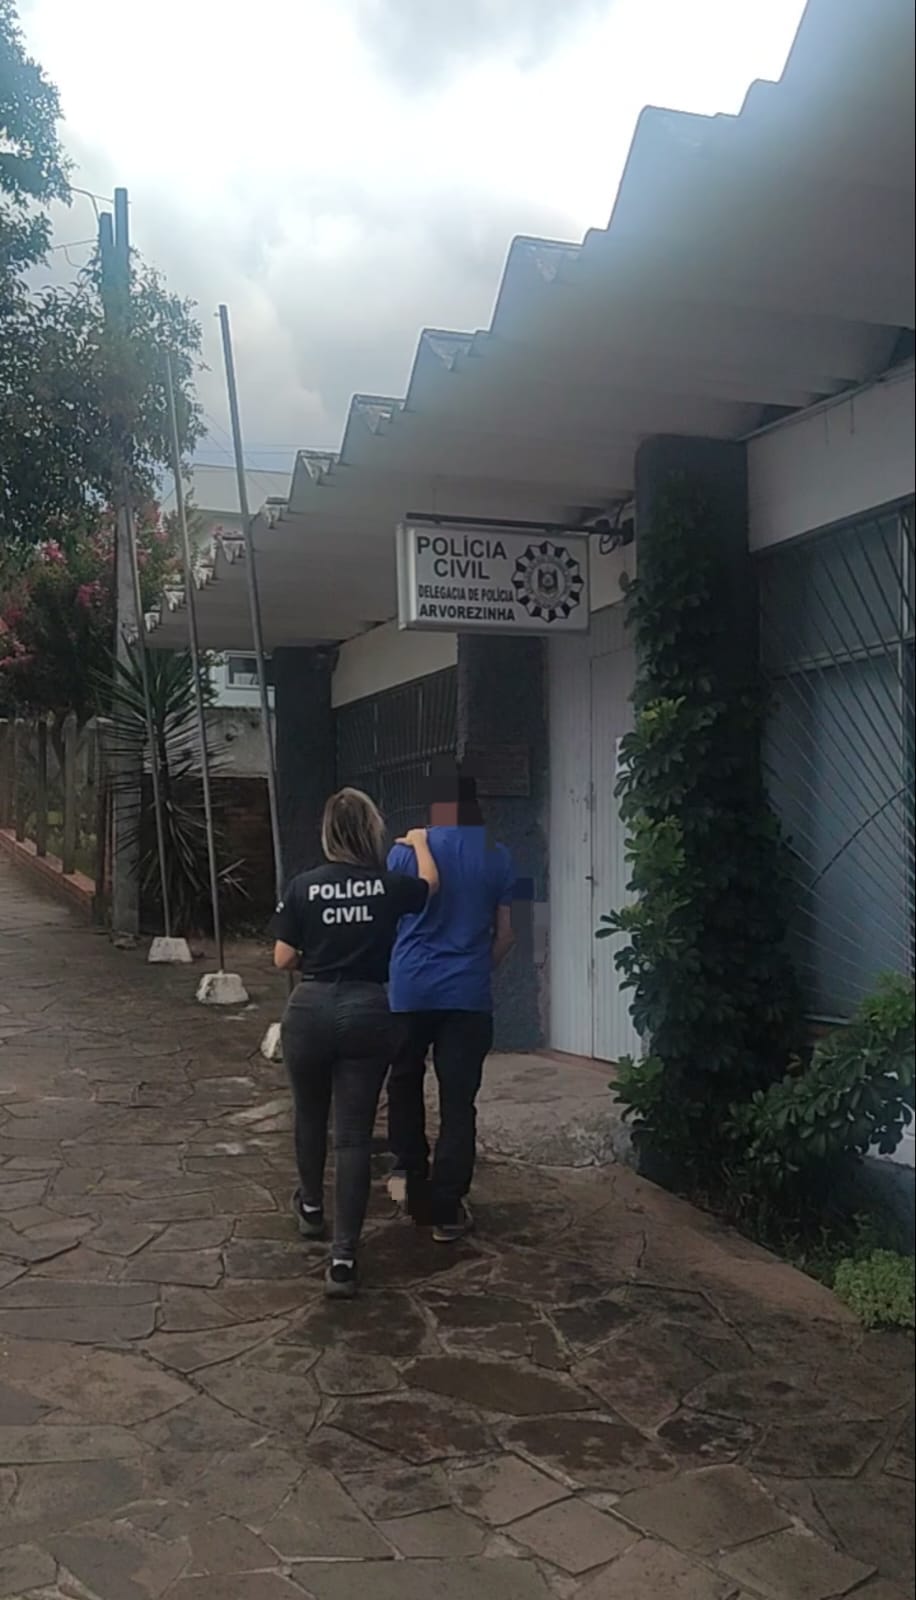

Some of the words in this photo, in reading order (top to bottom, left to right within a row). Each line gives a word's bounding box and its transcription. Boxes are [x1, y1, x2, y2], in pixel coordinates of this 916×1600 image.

[417, 535, 507, 560] POLÍCIA
[434, 559, 490, 580] CIVIL
[418, 584, 466, 601] DELEGACIA
[468, 587, 480, 601] DE
[481, 587, 514, 602] POLÍCIA
[419, 604, 516, 621] ARVOREZINHA
[308, 878, 385, 901] POLÍCIA
[322, 906, 374, 925] CIVIL
